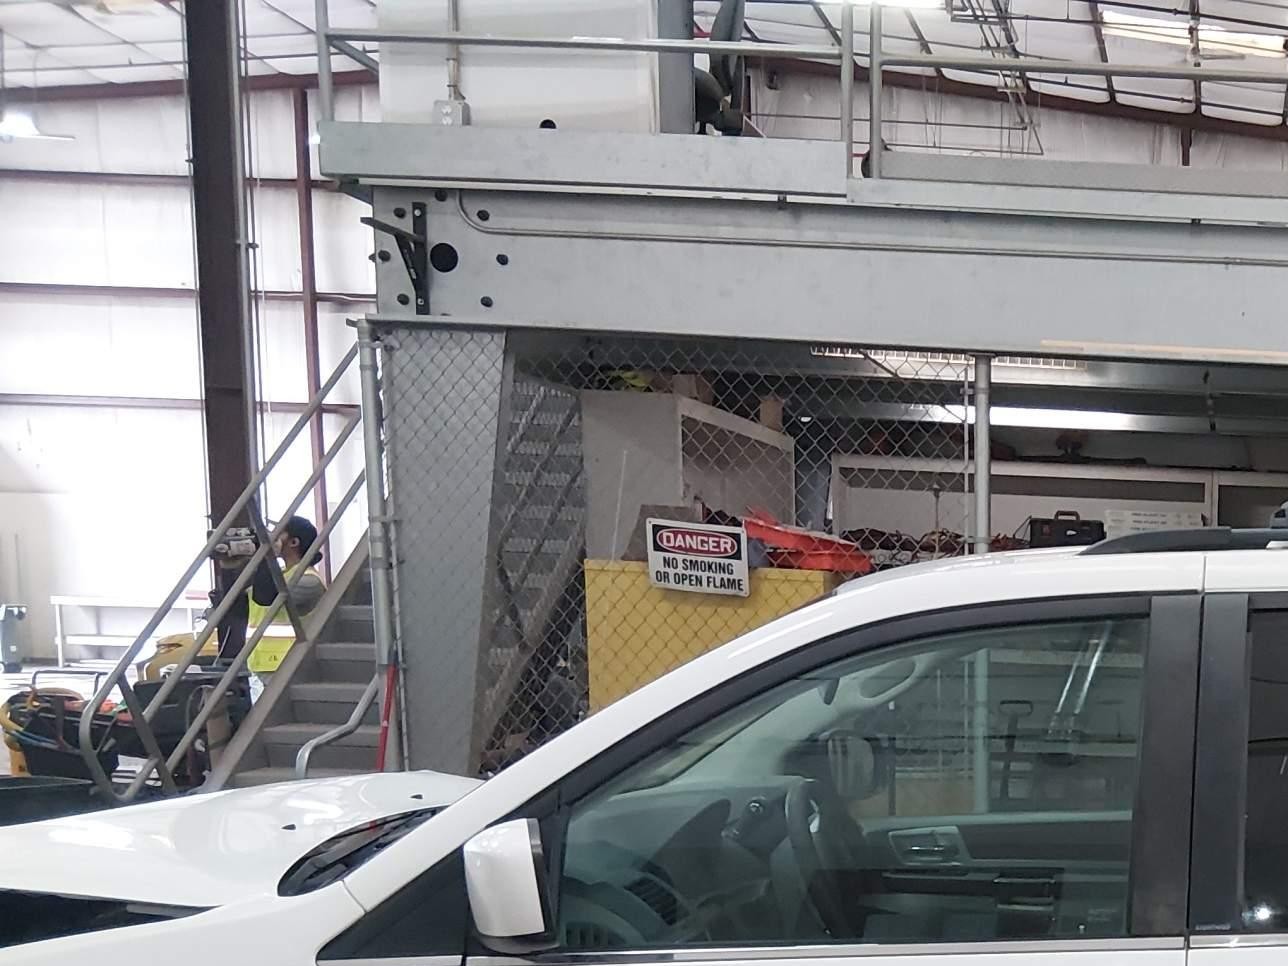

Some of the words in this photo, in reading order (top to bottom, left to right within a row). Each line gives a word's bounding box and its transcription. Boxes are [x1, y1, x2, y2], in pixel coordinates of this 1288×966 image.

[662, 532, 732, 553] DANGER
[663, 556, 679, 570] NO
[682, 559, 734, 575] SMOKING
[655, 570, 670, 584] OR
[673, 573, 703, 587] OPEN
[706, 576, 744, 592] FLAME
